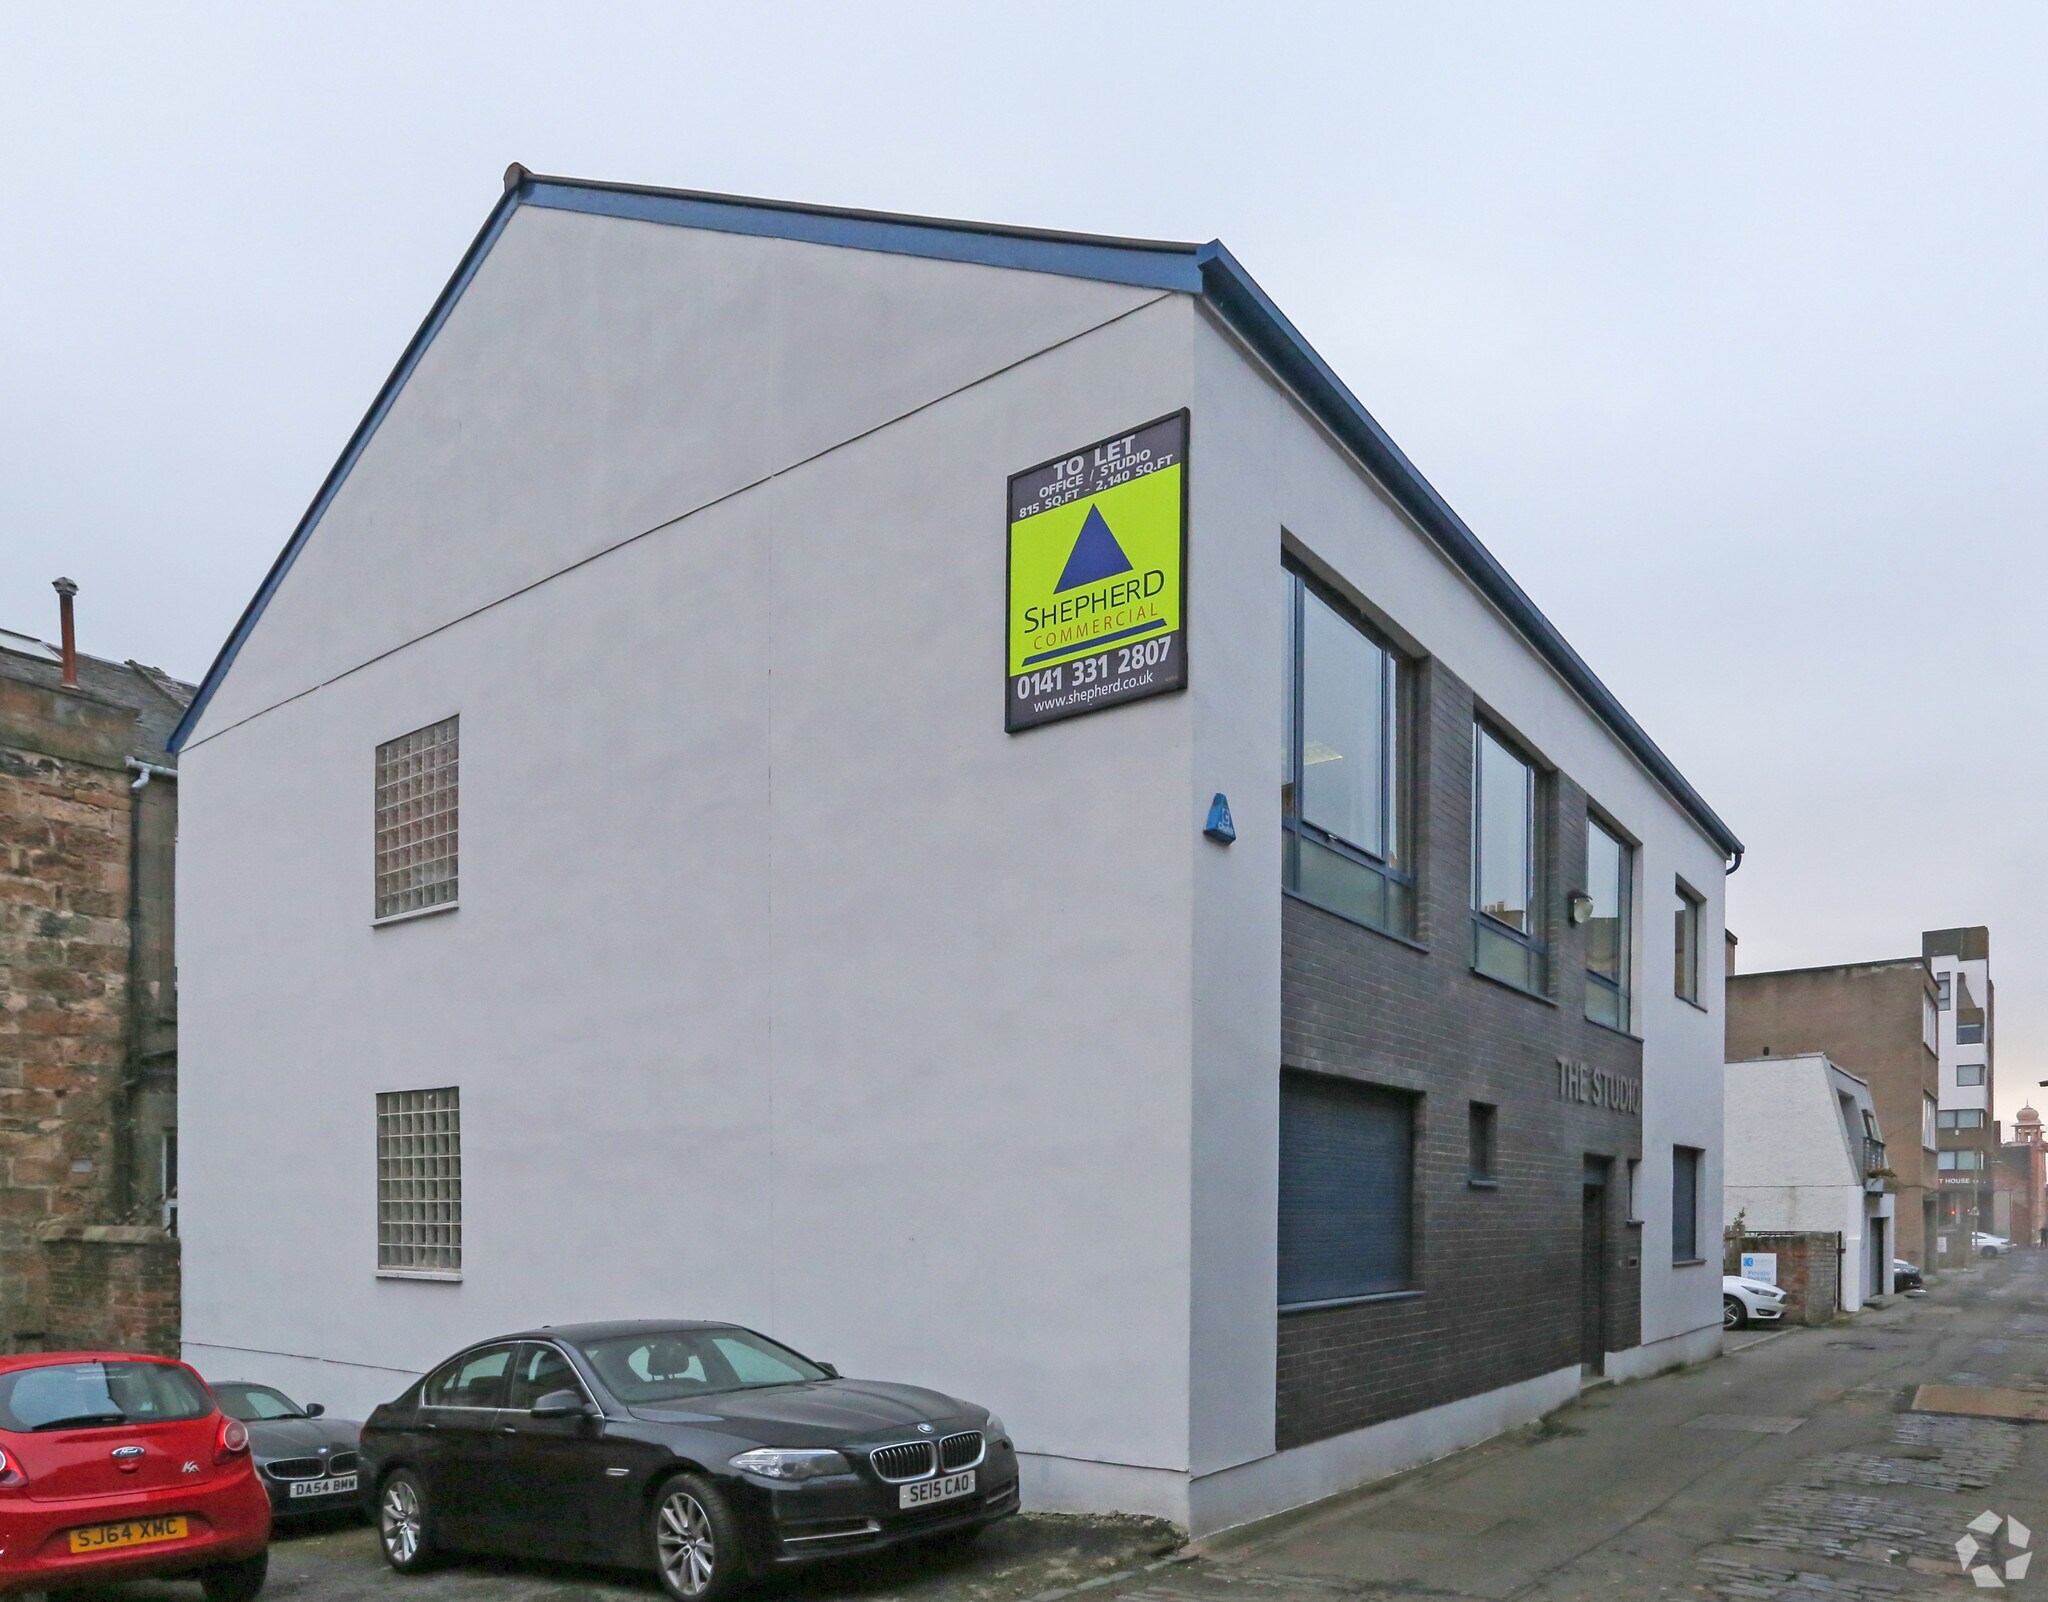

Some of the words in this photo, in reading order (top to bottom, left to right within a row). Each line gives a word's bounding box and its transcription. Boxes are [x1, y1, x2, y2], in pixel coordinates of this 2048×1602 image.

[1039, 474, 1084, 498] OFFICE
[1100, 449, 1151, 477] STUDIO
[1054, 455, 1084, 481] TO
[1094, 434, 1136, 467] LET
[1019, 503, 1040, 519] 815
[1044, 488, 1080, 509] SQ.FT
[1095, 470, 1130, 492] 2,140
[1135, 454, 1173, 477] SQ.FT
[1024, 569, 1165, 634] SHEPHERD
[1033, 602, 1158, 650] COMMERCIAL
[1017, 666, 1063, 700] 0141
[1071, 654, 1108, 687] 331
[1118, 635, 1172, 675] 2807
[1033, 670, 1154, 713] www.shepherd.co.uk
[1556, 1055, 1589, 1102] THE
[1591, 1066, 1641, 1115] STUDIO
[296, 1481, 330, 1495] DA54
[333, 1478, 356, 1491] BMW
[909, 1481, 942, 1503] SE15
[77, 1524, 133, 1548] SJ64
[140, 1519, 178, 1539] XMC
